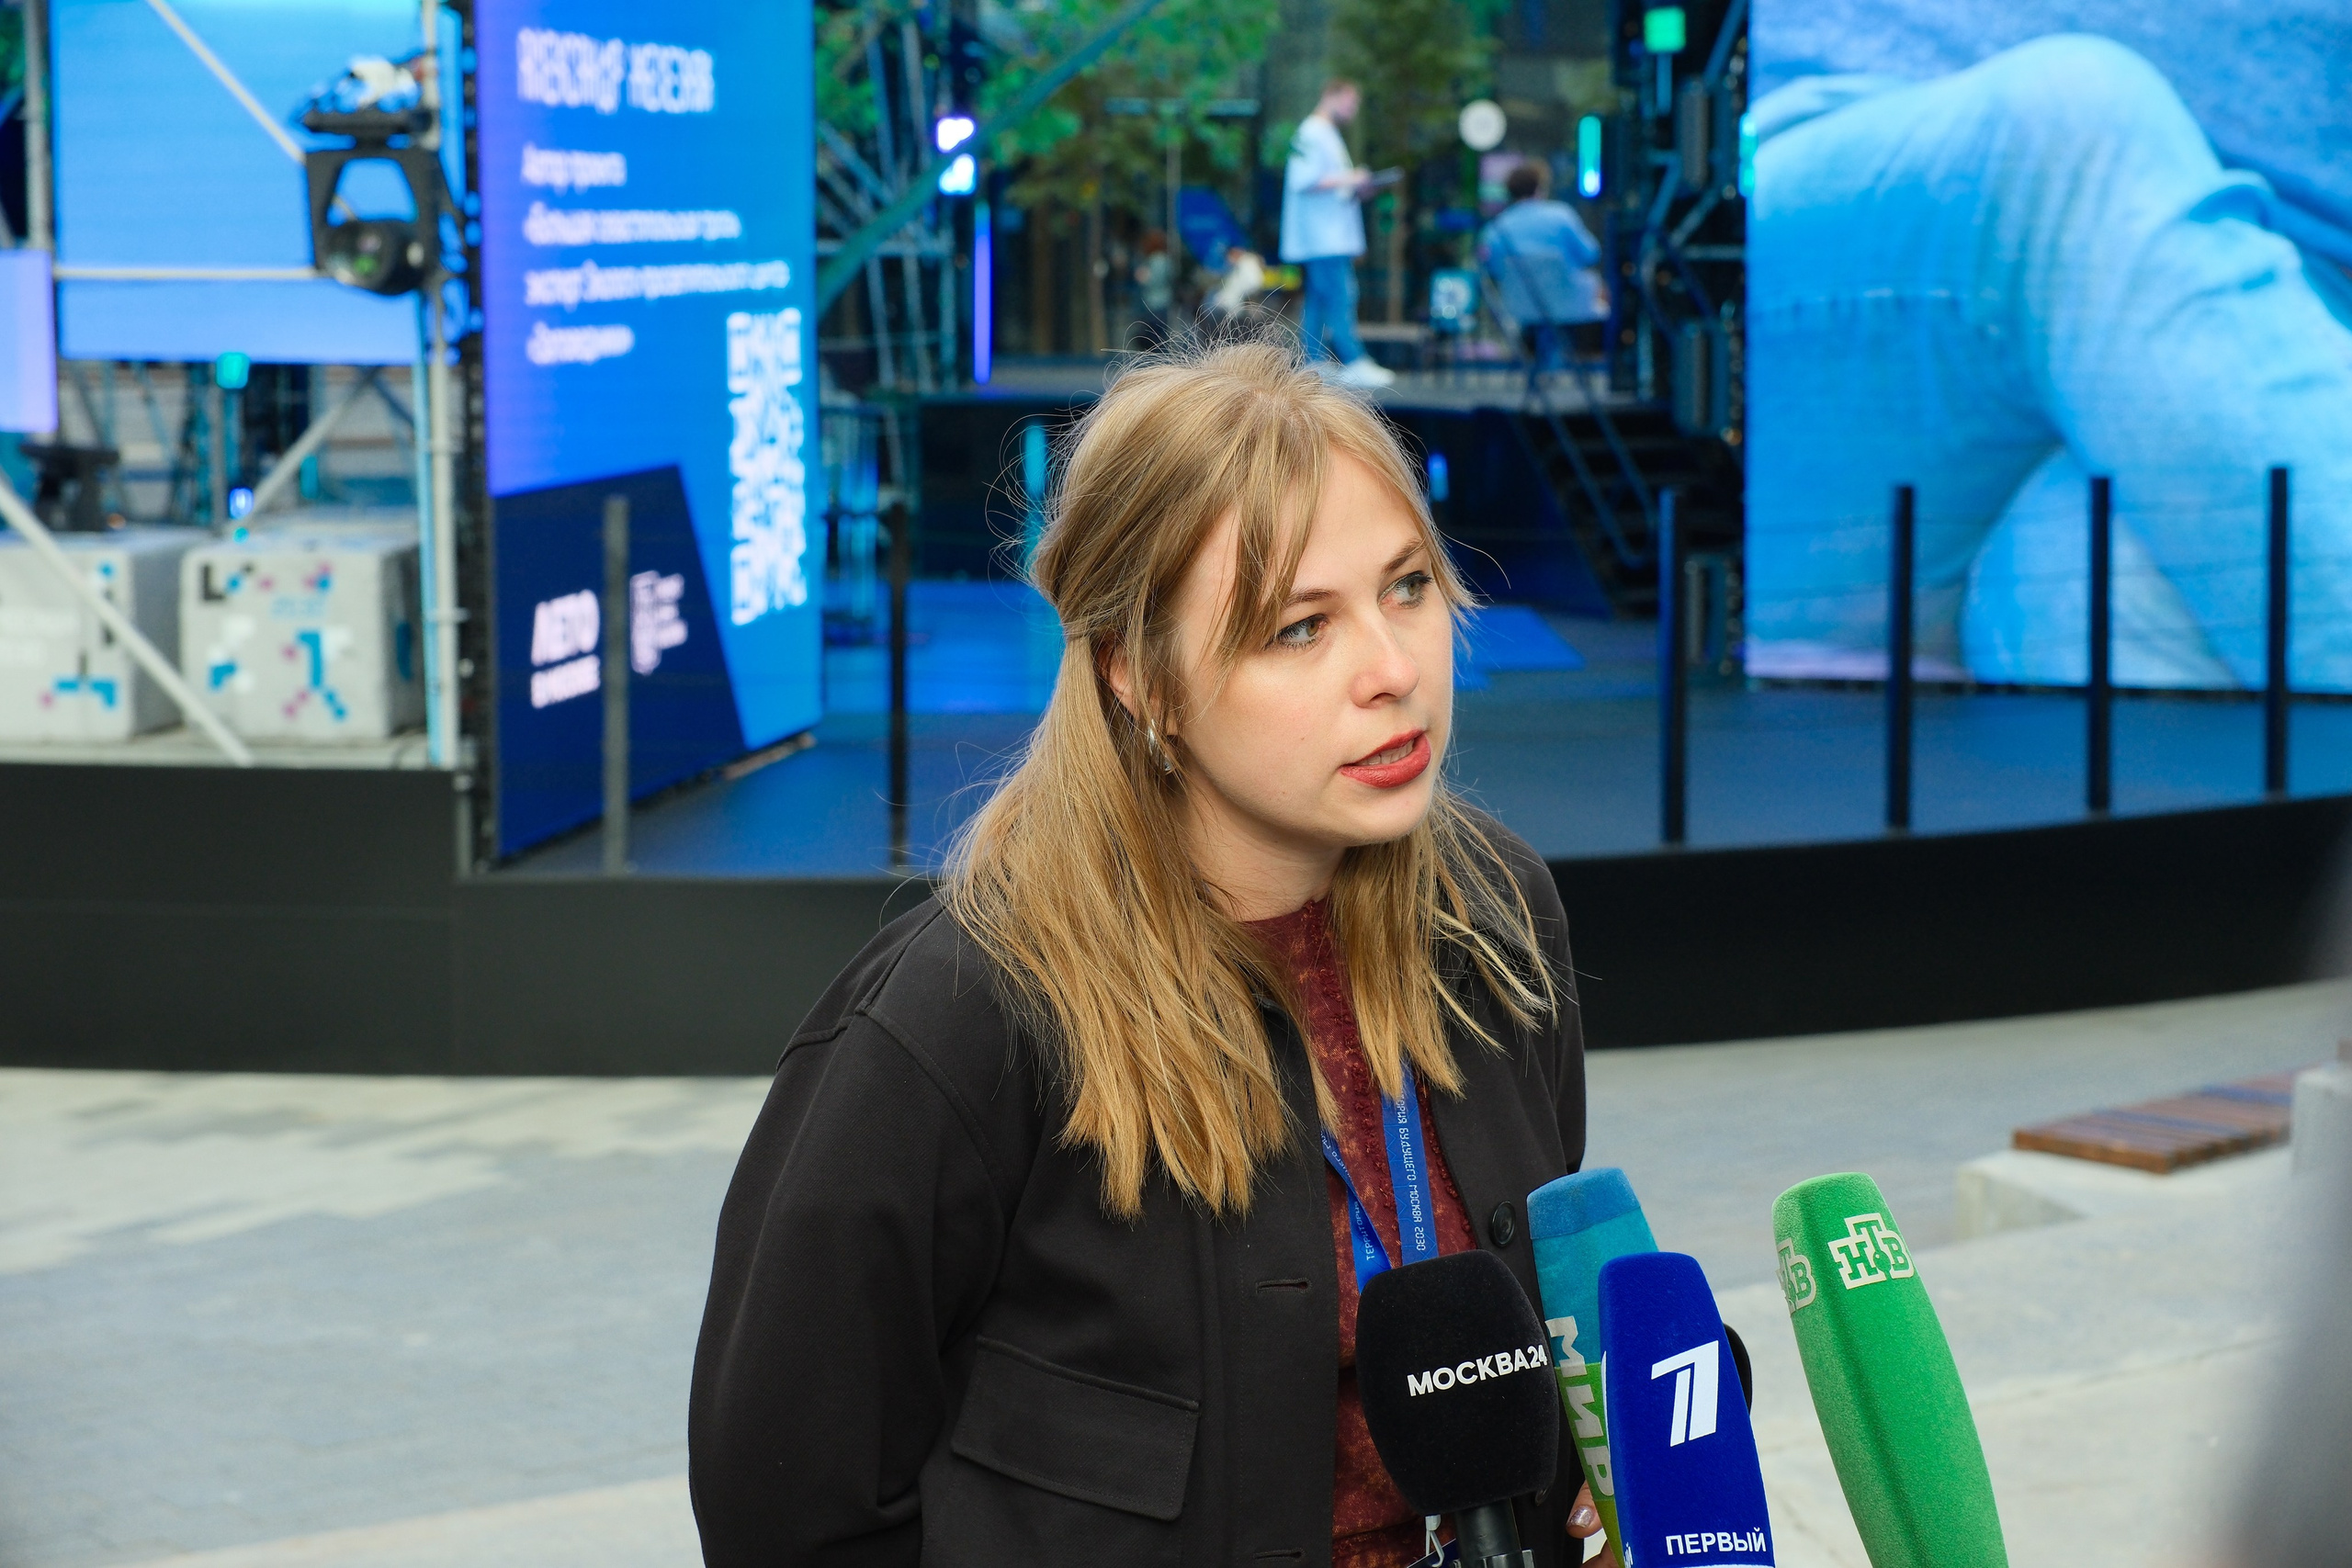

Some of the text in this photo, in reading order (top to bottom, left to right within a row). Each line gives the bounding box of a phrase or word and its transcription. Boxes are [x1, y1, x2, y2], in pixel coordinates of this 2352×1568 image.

[1398, 1127, 1417, 1181] БУДУЩЕГО
[1408, 1184, 1423, 1223] МОСКВА
[1414, 1226, 1426, 1251] 2030
[1828, 1213, 1914, 1290] НТВ
[1545, 1315, 1614, 1496] МИР
[1666, 1527, 1767, 1555] ПЕРВЫЙ
